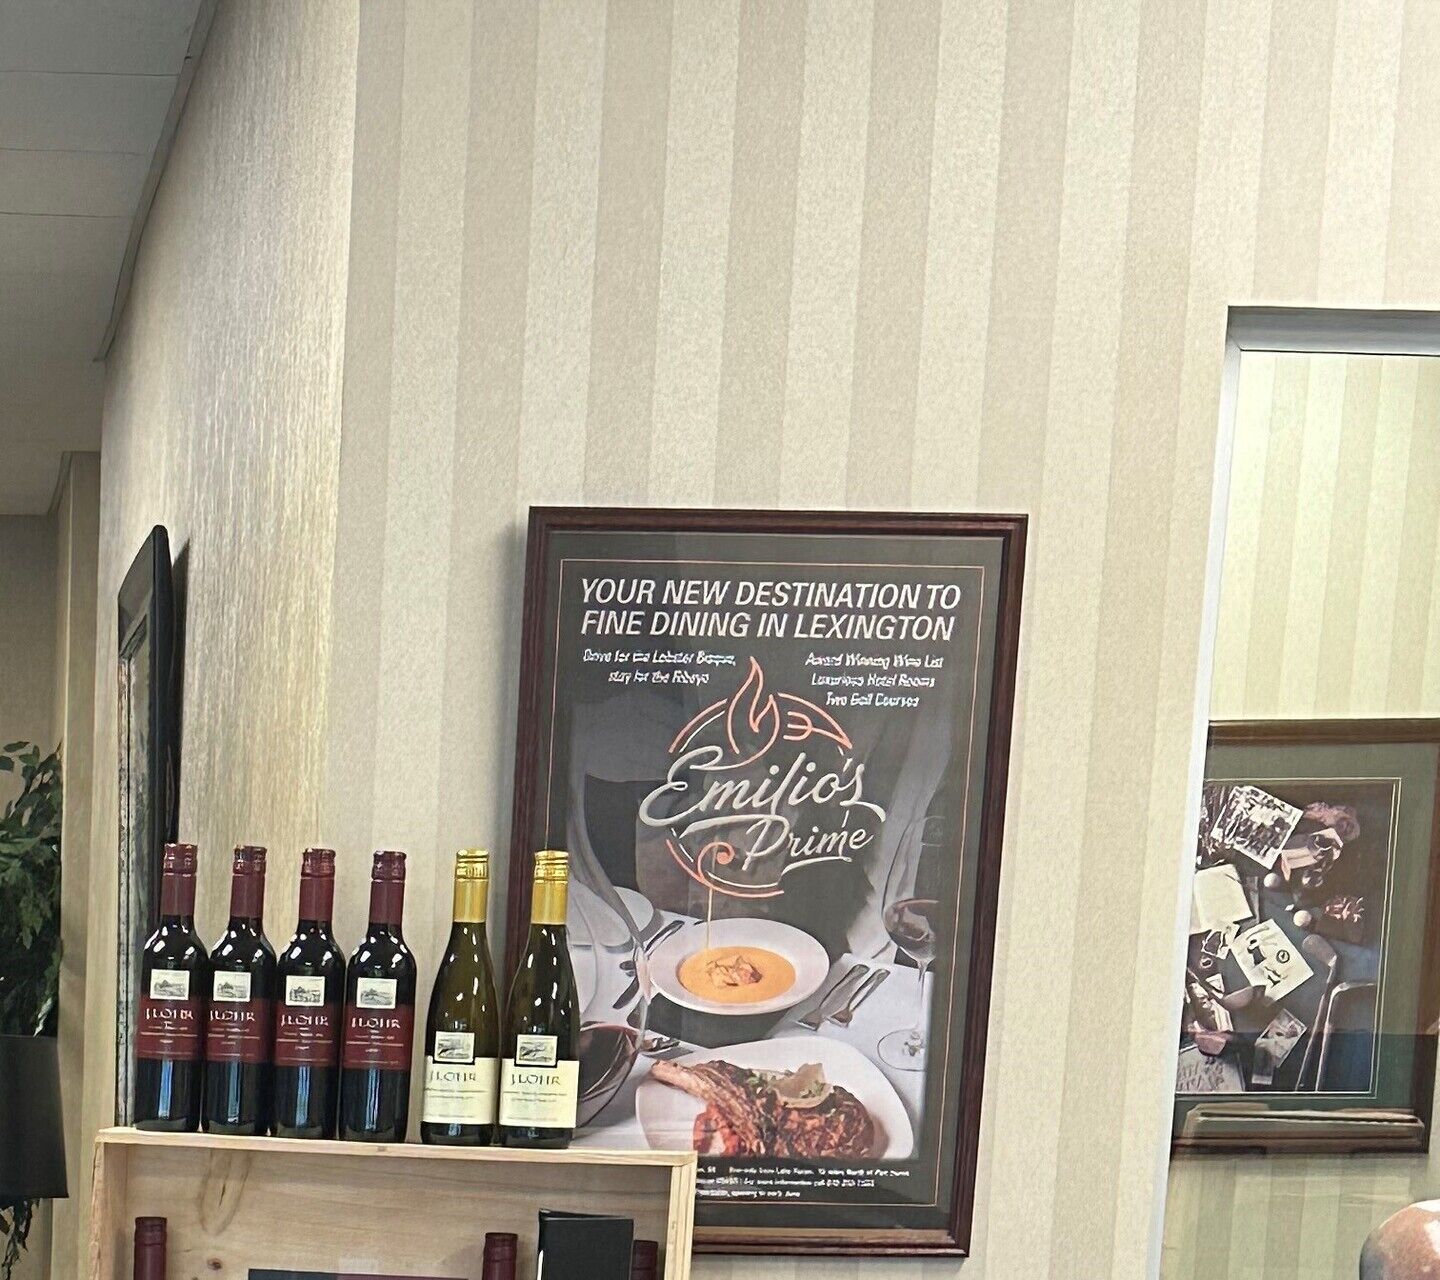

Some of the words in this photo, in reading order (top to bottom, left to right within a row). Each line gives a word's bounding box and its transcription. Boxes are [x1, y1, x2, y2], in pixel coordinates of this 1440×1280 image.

[581, 578, 655, 604] YOUR
[664, 580, 730, 606] NEW
[735, 582, 923, 609] DESTINATION
[927, 584, 962, 610] TO
[581, 610, 643, 635] FINE
[650, 612, 749, 637] DINING
[757, 613, 785, 638] IN
[794, 614, 956, 641] LEXINGTON
[639, 746, 886, 827] Emilio's
[732, 814, 874, 872] Prime
